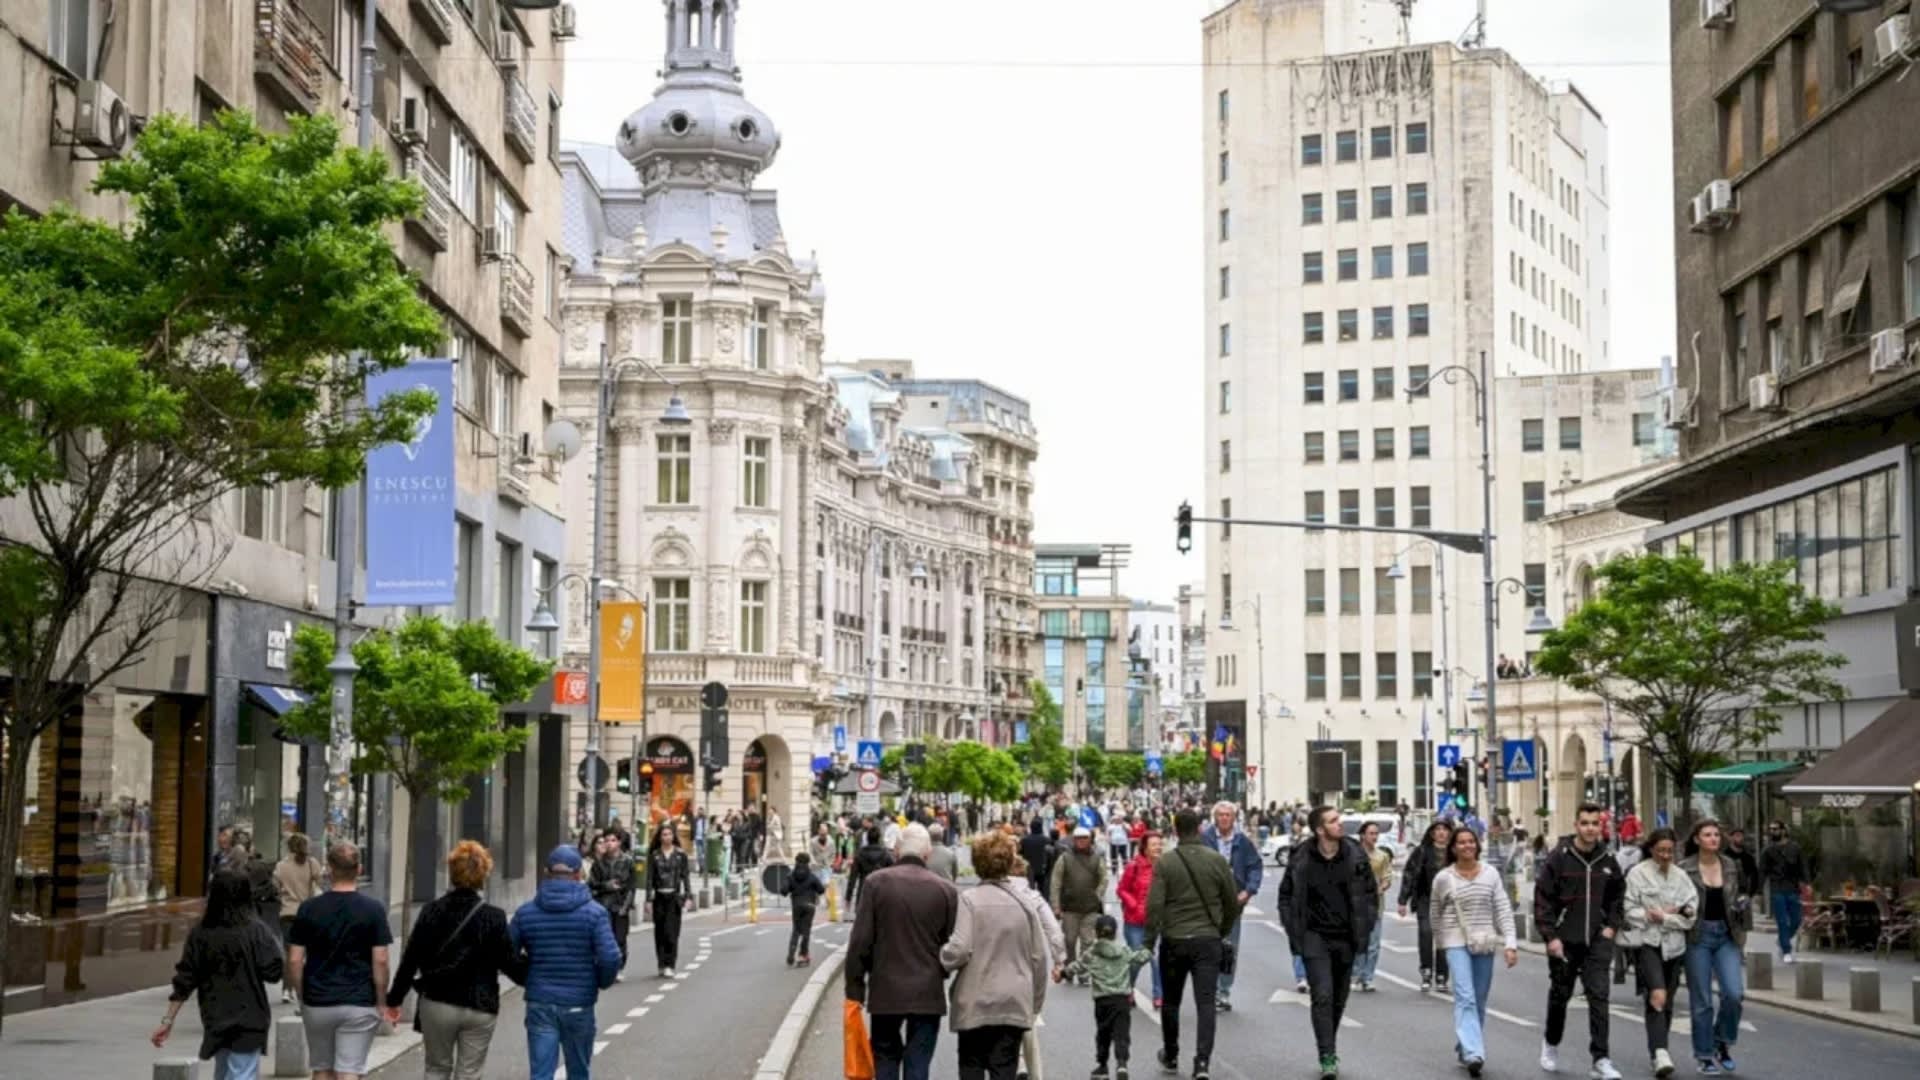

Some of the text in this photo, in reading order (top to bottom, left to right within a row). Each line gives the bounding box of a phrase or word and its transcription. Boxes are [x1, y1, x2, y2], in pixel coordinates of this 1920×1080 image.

[375, 476, 448, 490] ENESCU
[656, 696, 697, 709] GRAN
[728, 698, 768, 711] OTEL
